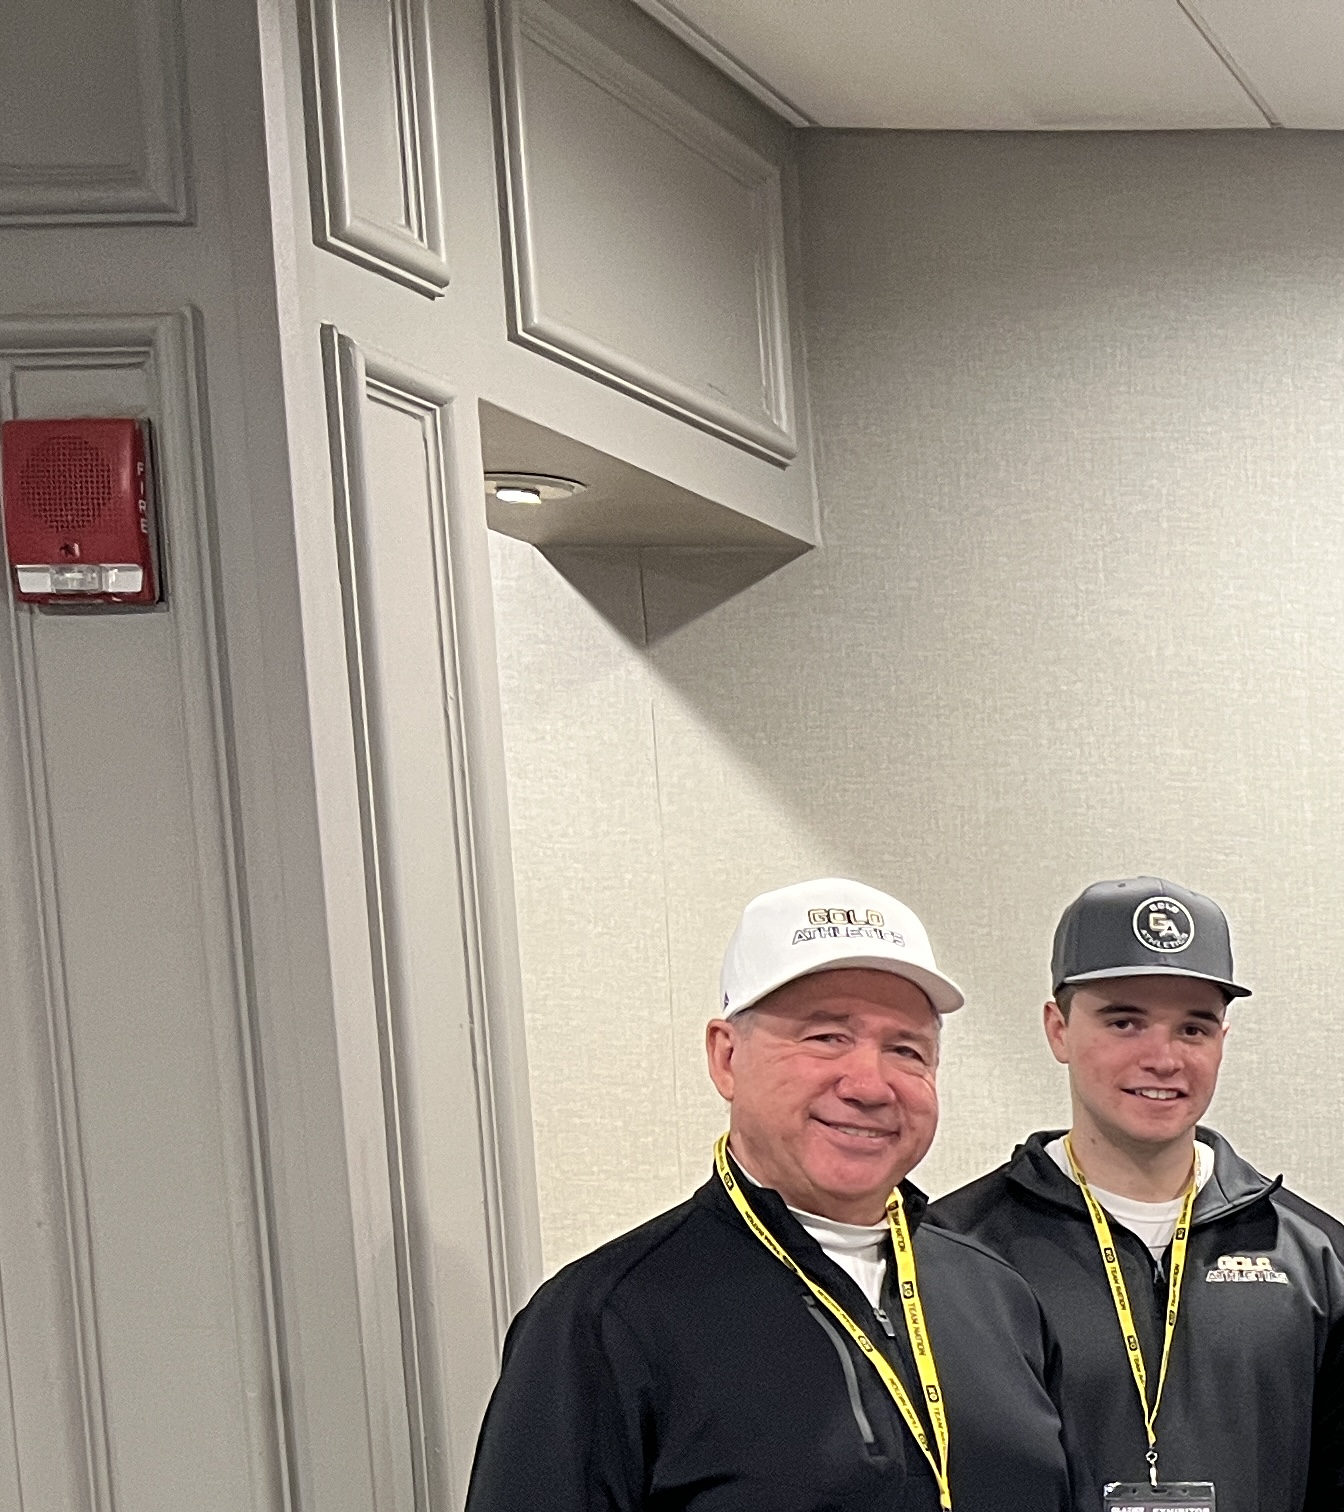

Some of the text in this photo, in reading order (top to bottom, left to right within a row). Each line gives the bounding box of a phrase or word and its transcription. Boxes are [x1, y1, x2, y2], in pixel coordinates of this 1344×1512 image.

[137, 461, 148, 534] FIRE
[808, 908, 885, 928] GOLD
[1149, 902, 1180, 914] GOLD
[1149, 912, 1181, 938] GA
[792, 927, 906, 948] ATHLETICS
[1217, 1255, 1273, 1272] GOLD
[1205, 1270, 1289, 1285] ATHLETICS
[912, 1325, 927, 1357] NATION
